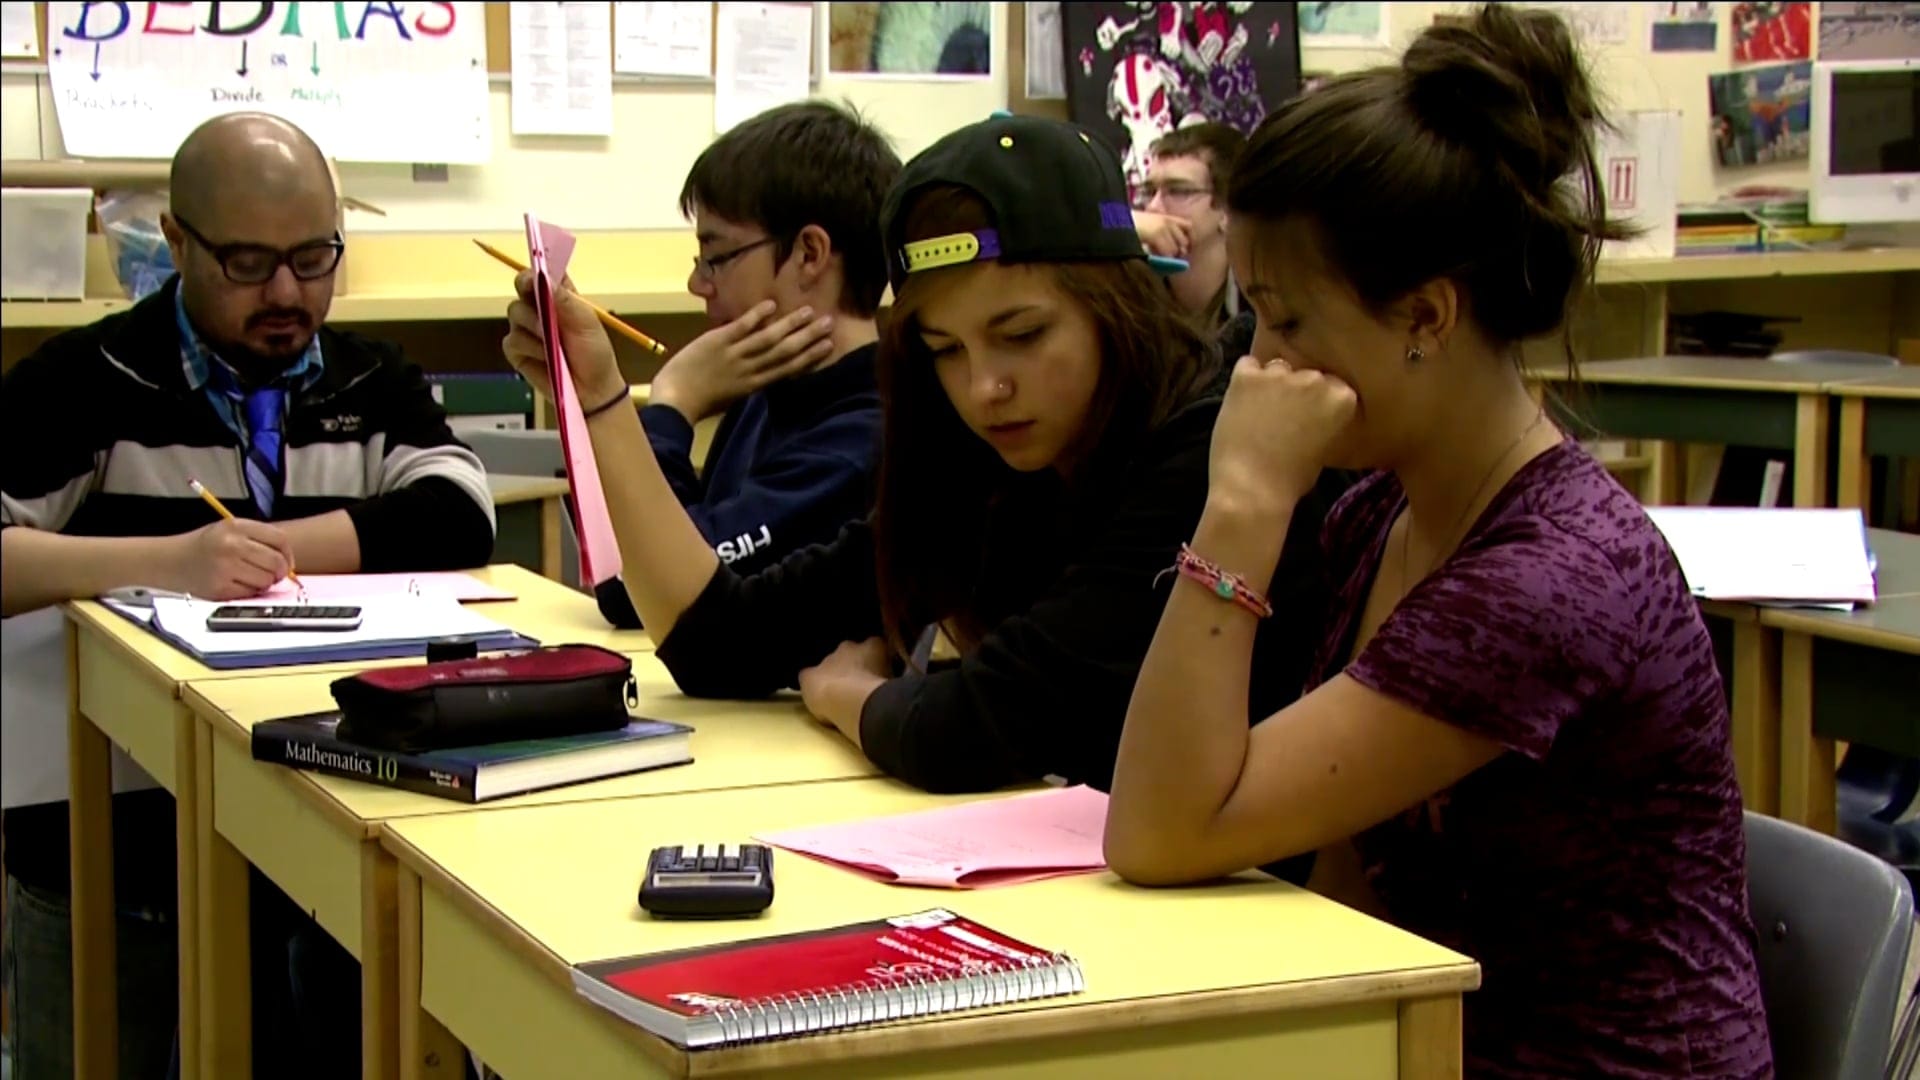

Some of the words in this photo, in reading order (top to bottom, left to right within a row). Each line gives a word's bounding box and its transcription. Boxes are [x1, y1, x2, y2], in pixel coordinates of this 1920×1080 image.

[210, 86, 264, 103] Divide
[285, 739, 372, 775] Mathematics
[376, 755, 399, 782] 10
